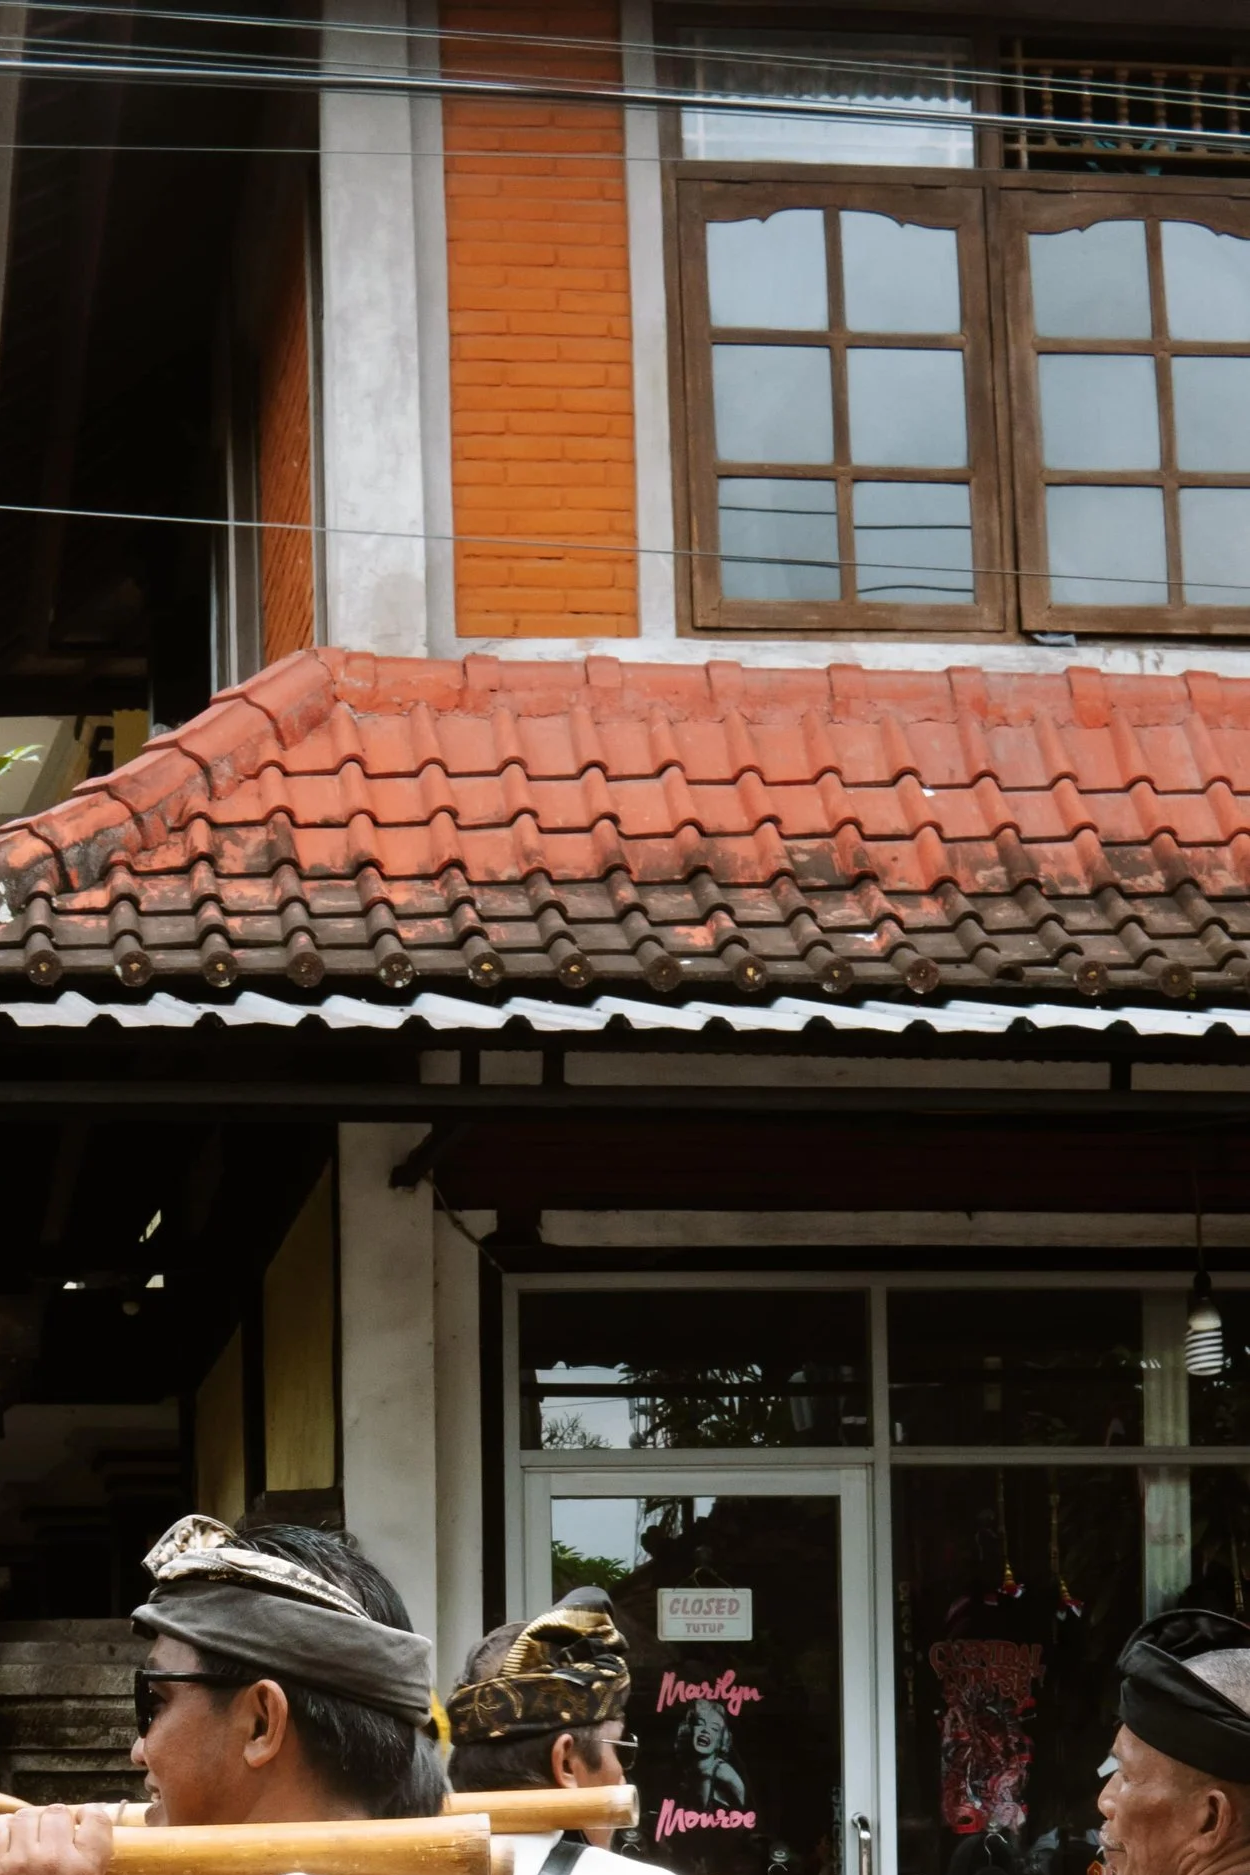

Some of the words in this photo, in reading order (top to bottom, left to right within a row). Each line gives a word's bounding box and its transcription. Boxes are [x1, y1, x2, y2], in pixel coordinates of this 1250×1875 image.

[669, 1597, 741, 1616] CLOSED
[685, 1623, 725, 1633] TUTUP
[656, 1669, 764, 1717] Marilyn
[655, 1798, 757, 1842] Monroe
